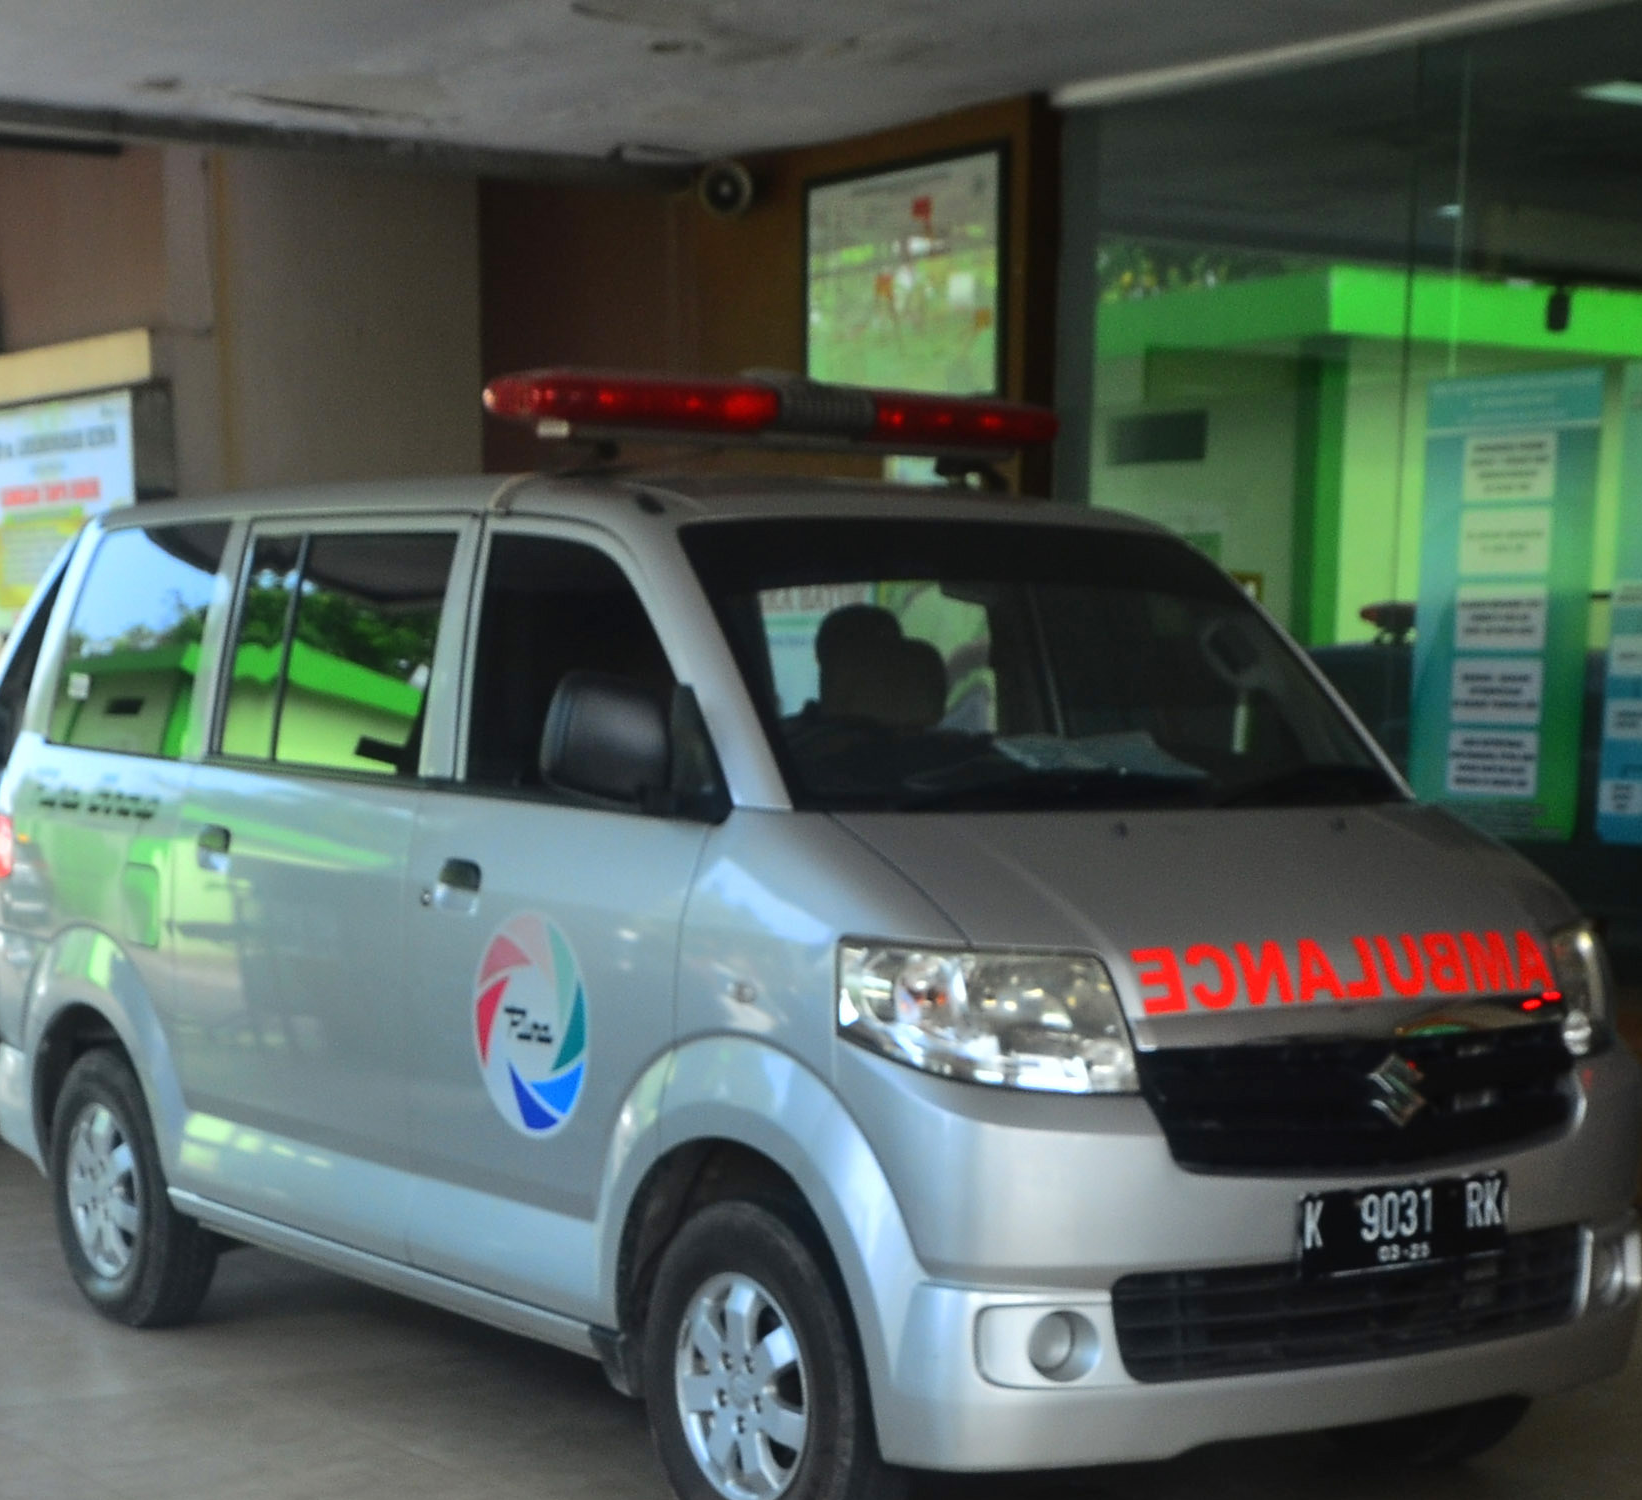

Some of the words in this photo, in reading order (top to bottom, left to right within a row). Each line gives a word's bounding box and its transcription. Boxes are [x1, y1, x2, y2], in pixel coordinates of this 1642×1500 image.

[1304, 1200, 1324, 1249] K
[1360, 1188, 1434, 1242] 9031
[1465, 1179, 1502, 1228] RK
